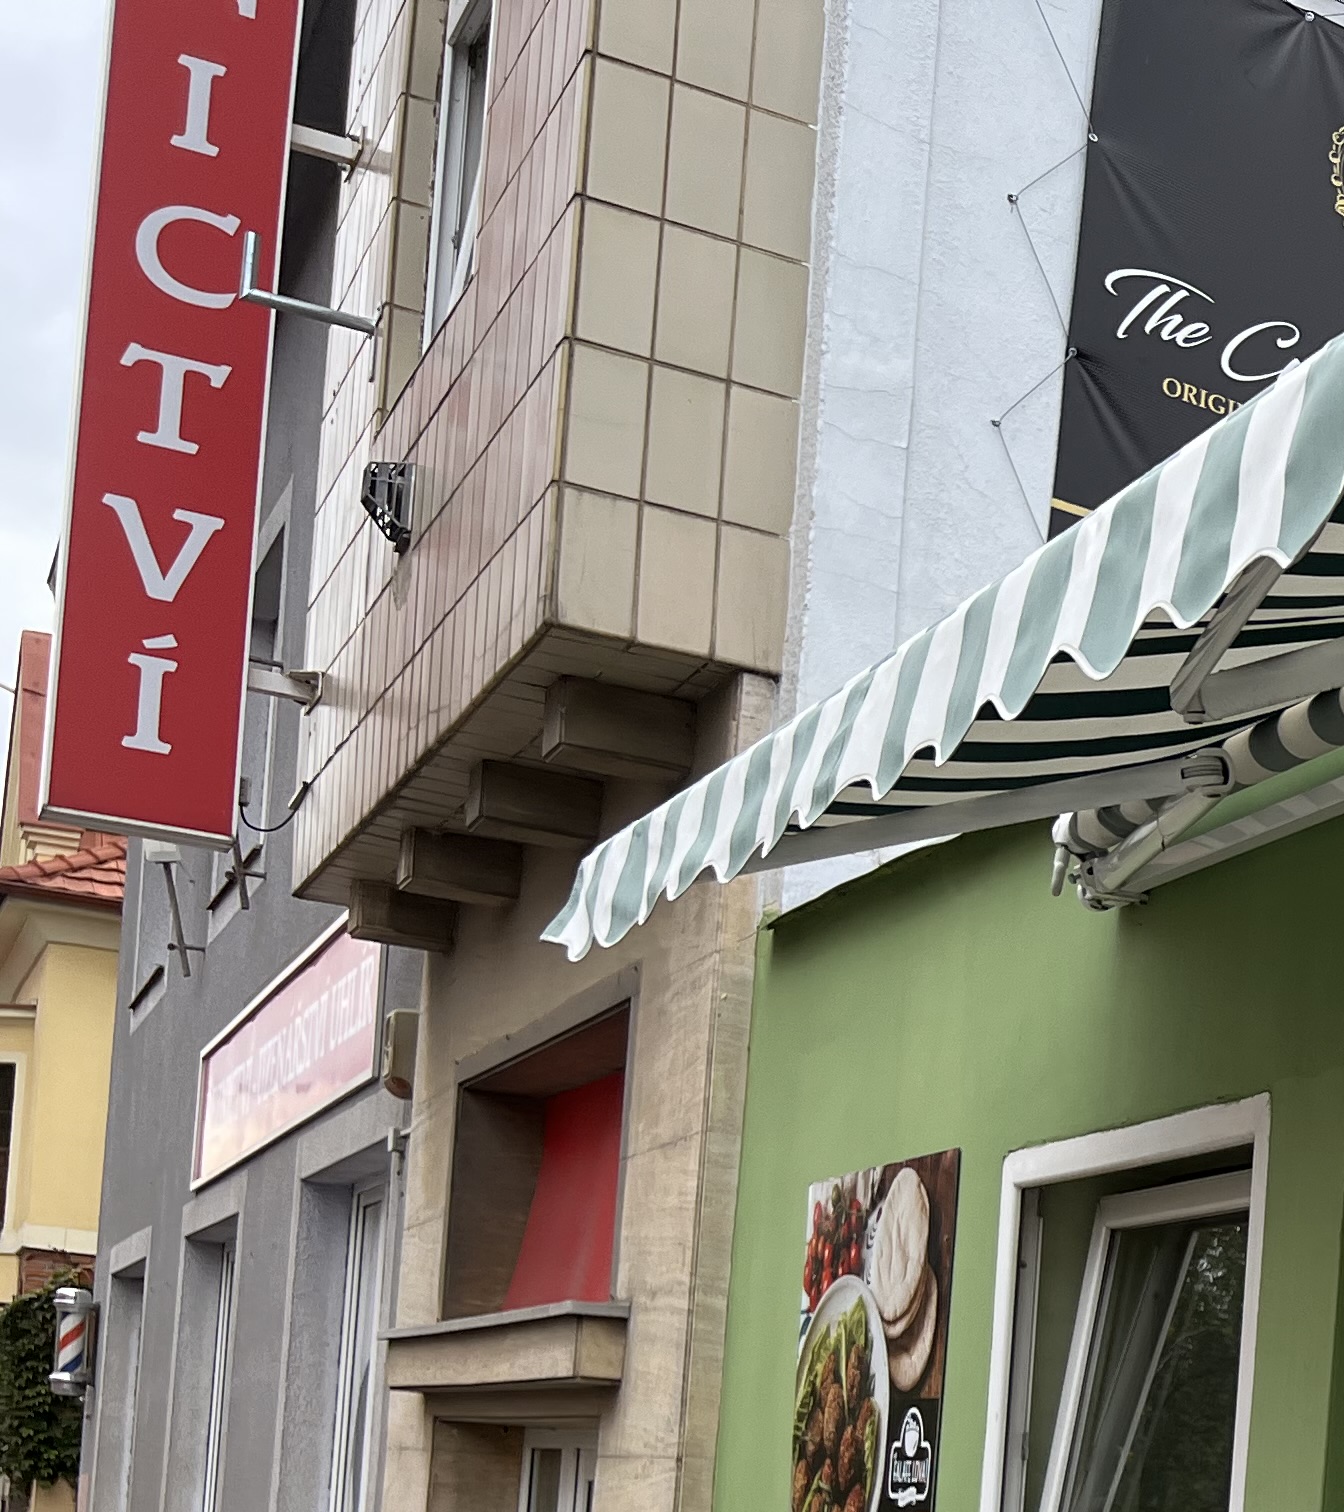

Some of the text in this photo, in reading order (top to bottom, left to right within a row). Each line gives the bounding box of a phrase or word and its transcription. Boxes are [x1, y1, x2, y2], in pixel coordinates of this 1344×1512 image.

[102, 0, 258, 756] ICTVÍ
[1104, 268, 1301, 382] The C
